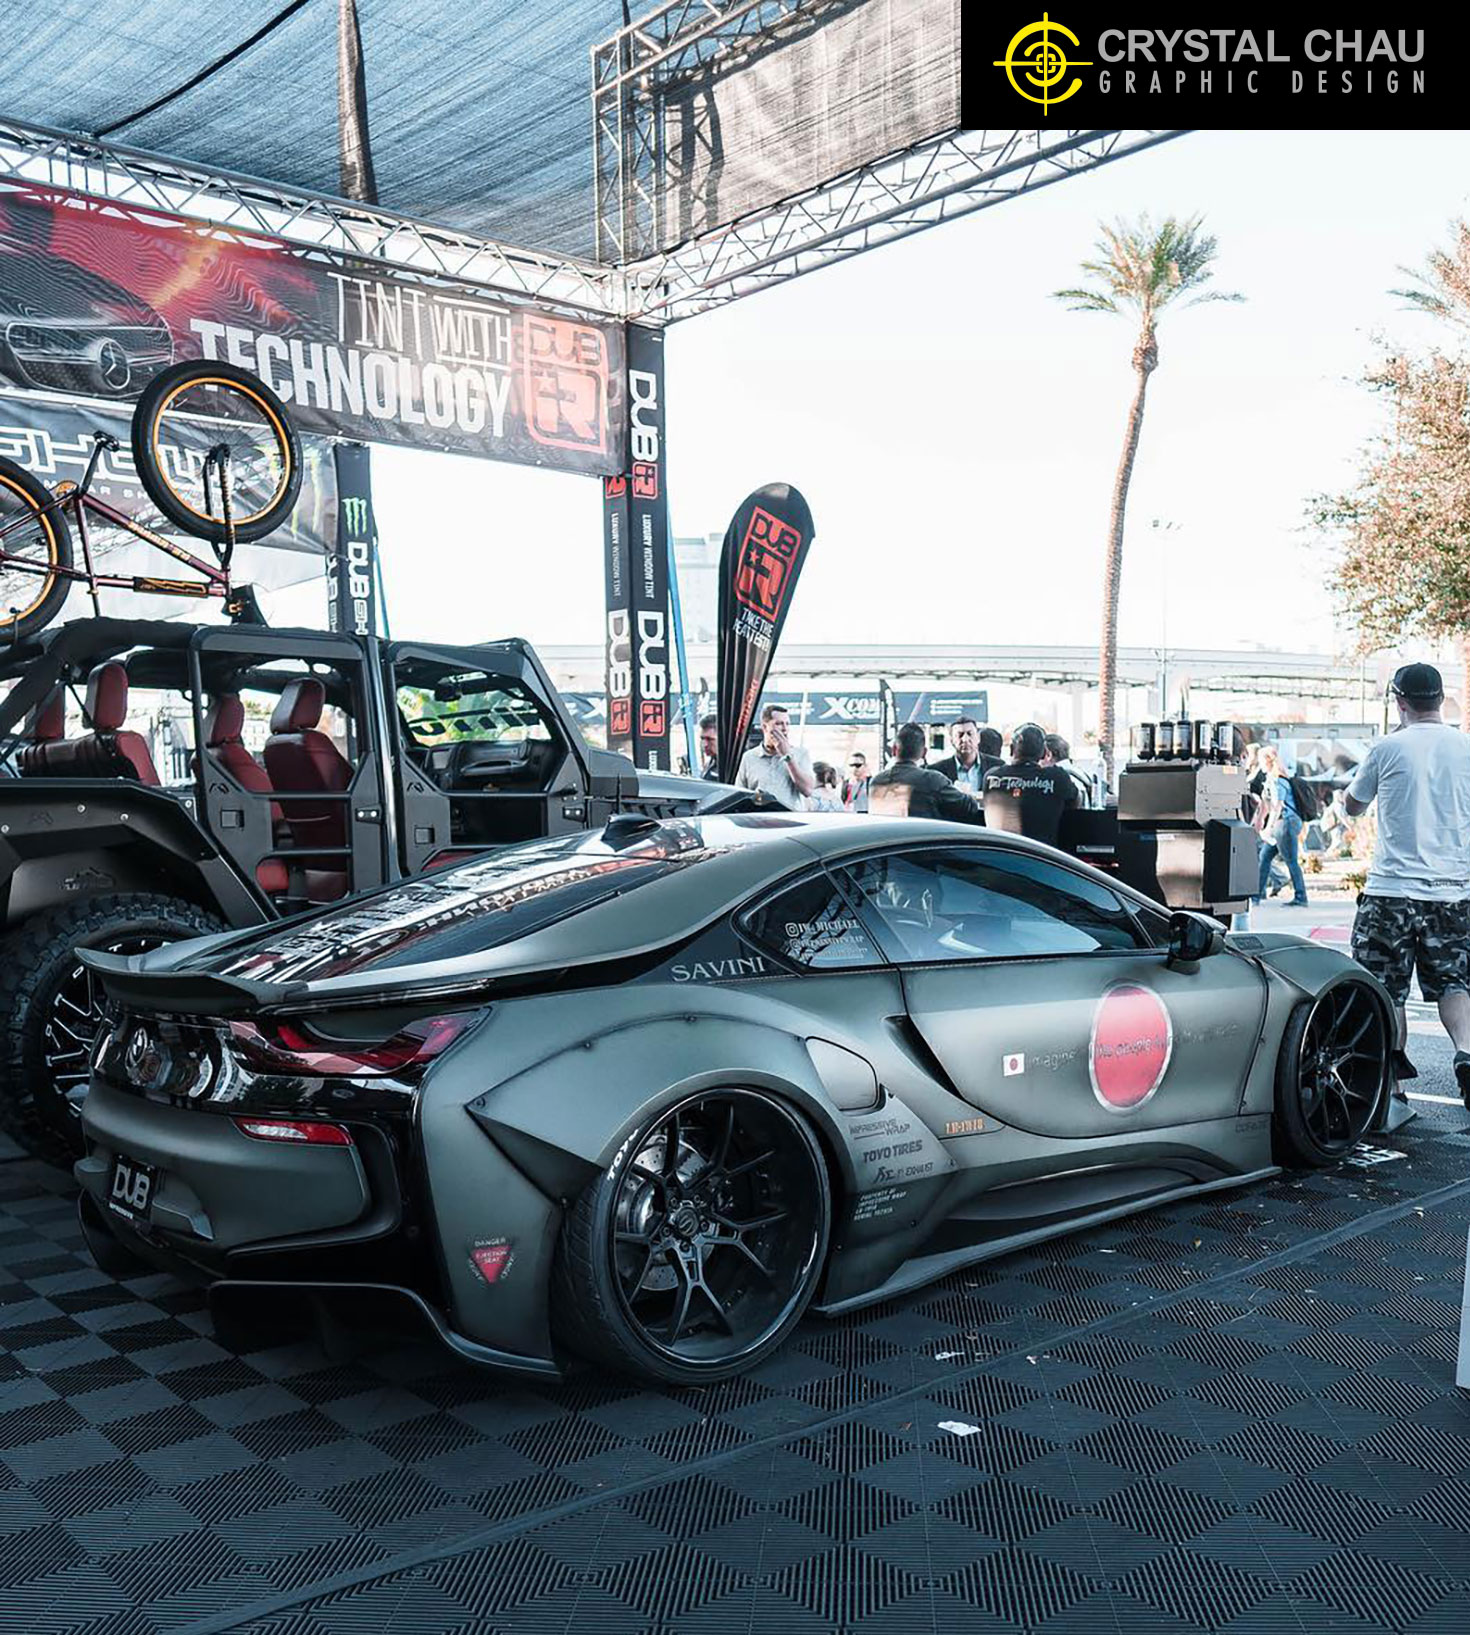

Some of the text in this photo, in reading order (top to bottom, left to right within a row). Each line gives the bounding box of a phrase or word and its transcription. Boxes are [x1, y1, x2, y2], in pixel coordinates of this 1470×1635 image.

[327, 271, 512, 363] TINT WITH
[189, 318, 512, 437] TECHNOLOGY
[629, 369, 659, 462] DUB
[348, 541, 370, 598] DUB
[642, 514, 654, 599] LUXURY WINDOW TINT
[749, 512, 799, 558] DUB
[608, 609, 631, 698] DUB
[638, 611, 666, 700] DUB
[671, 956, 765, 982] SAVINI
[112, 1163, 150, 1210] DUB
[863, 1140, 923, 1163] TOYO TIRES
[475, 1237, 506, 1247] DANGER
